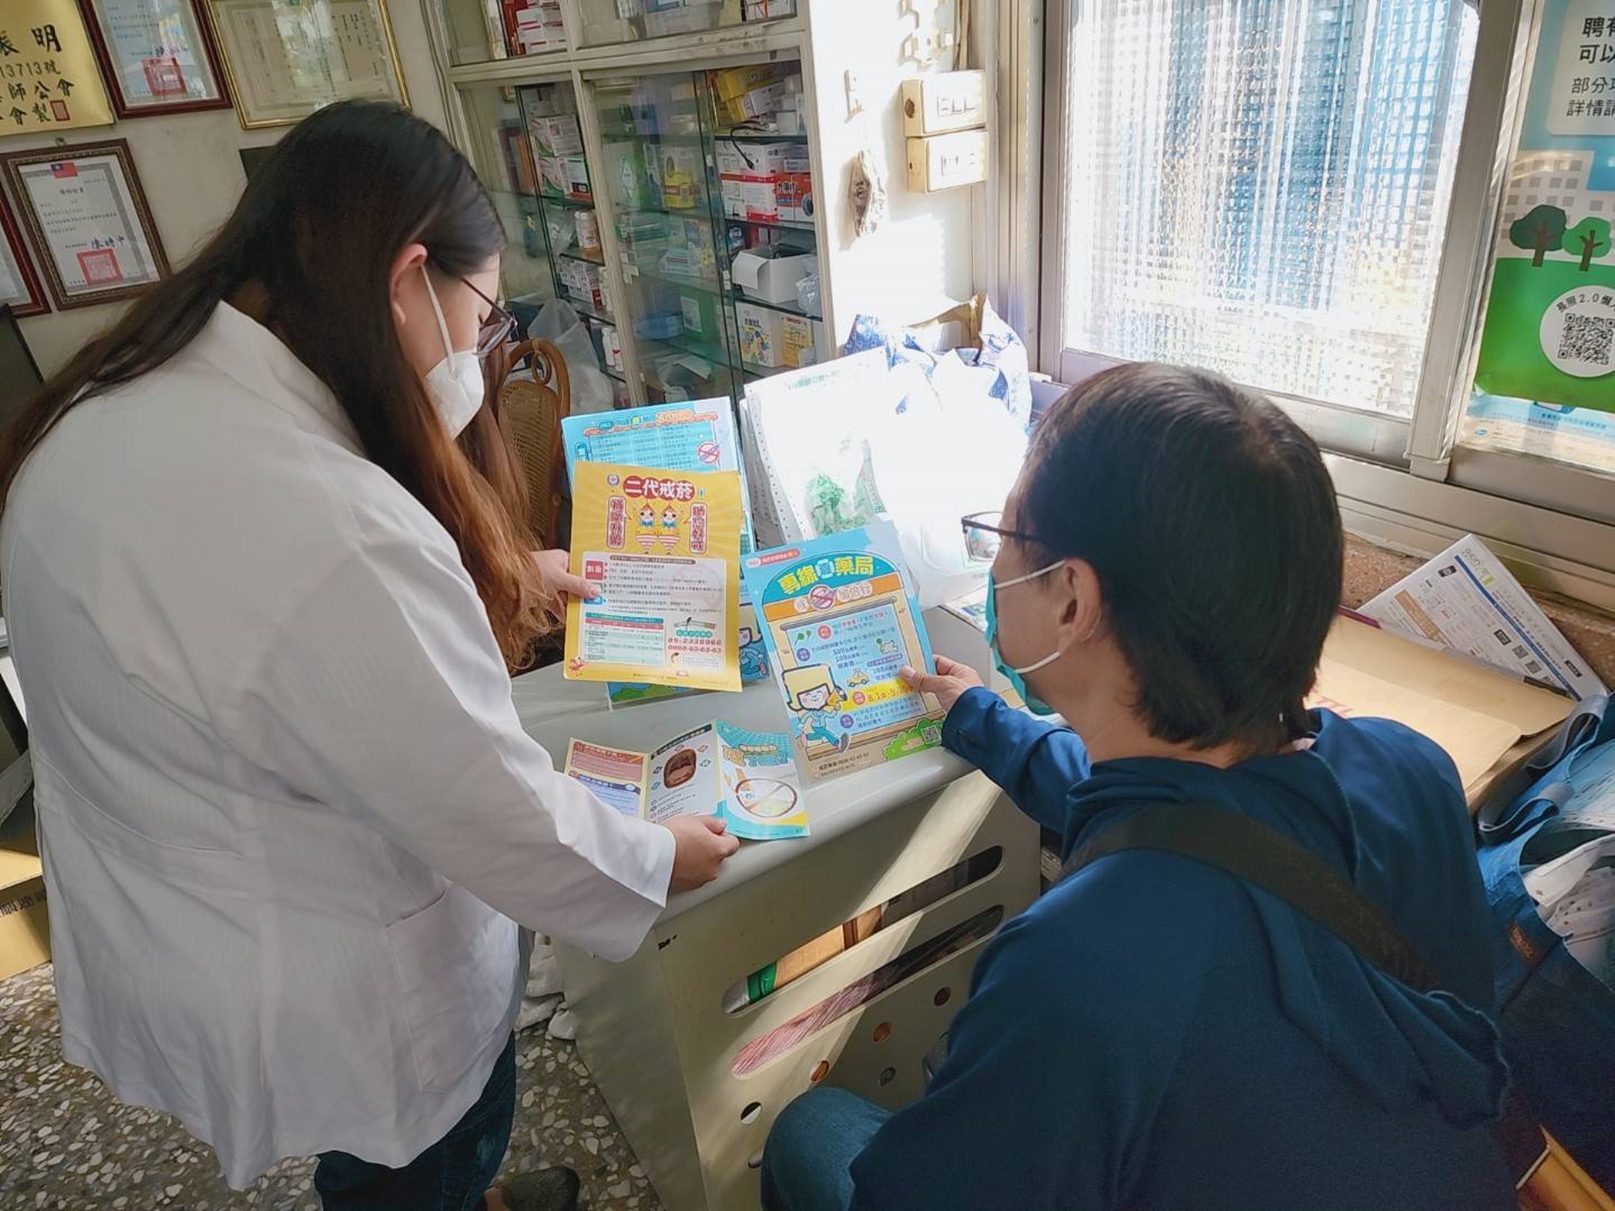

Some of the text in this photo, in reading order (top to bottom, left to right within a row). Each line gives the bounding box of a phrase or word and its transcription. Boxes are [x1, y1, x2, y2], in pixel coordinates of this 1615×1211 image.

[1579, 43, 1615, 64] 可以
[0, 78, 75, 101] 師公會
[0, 102, 52, 126] 會製
[624, 478, 693, 500] 二代戒菸
